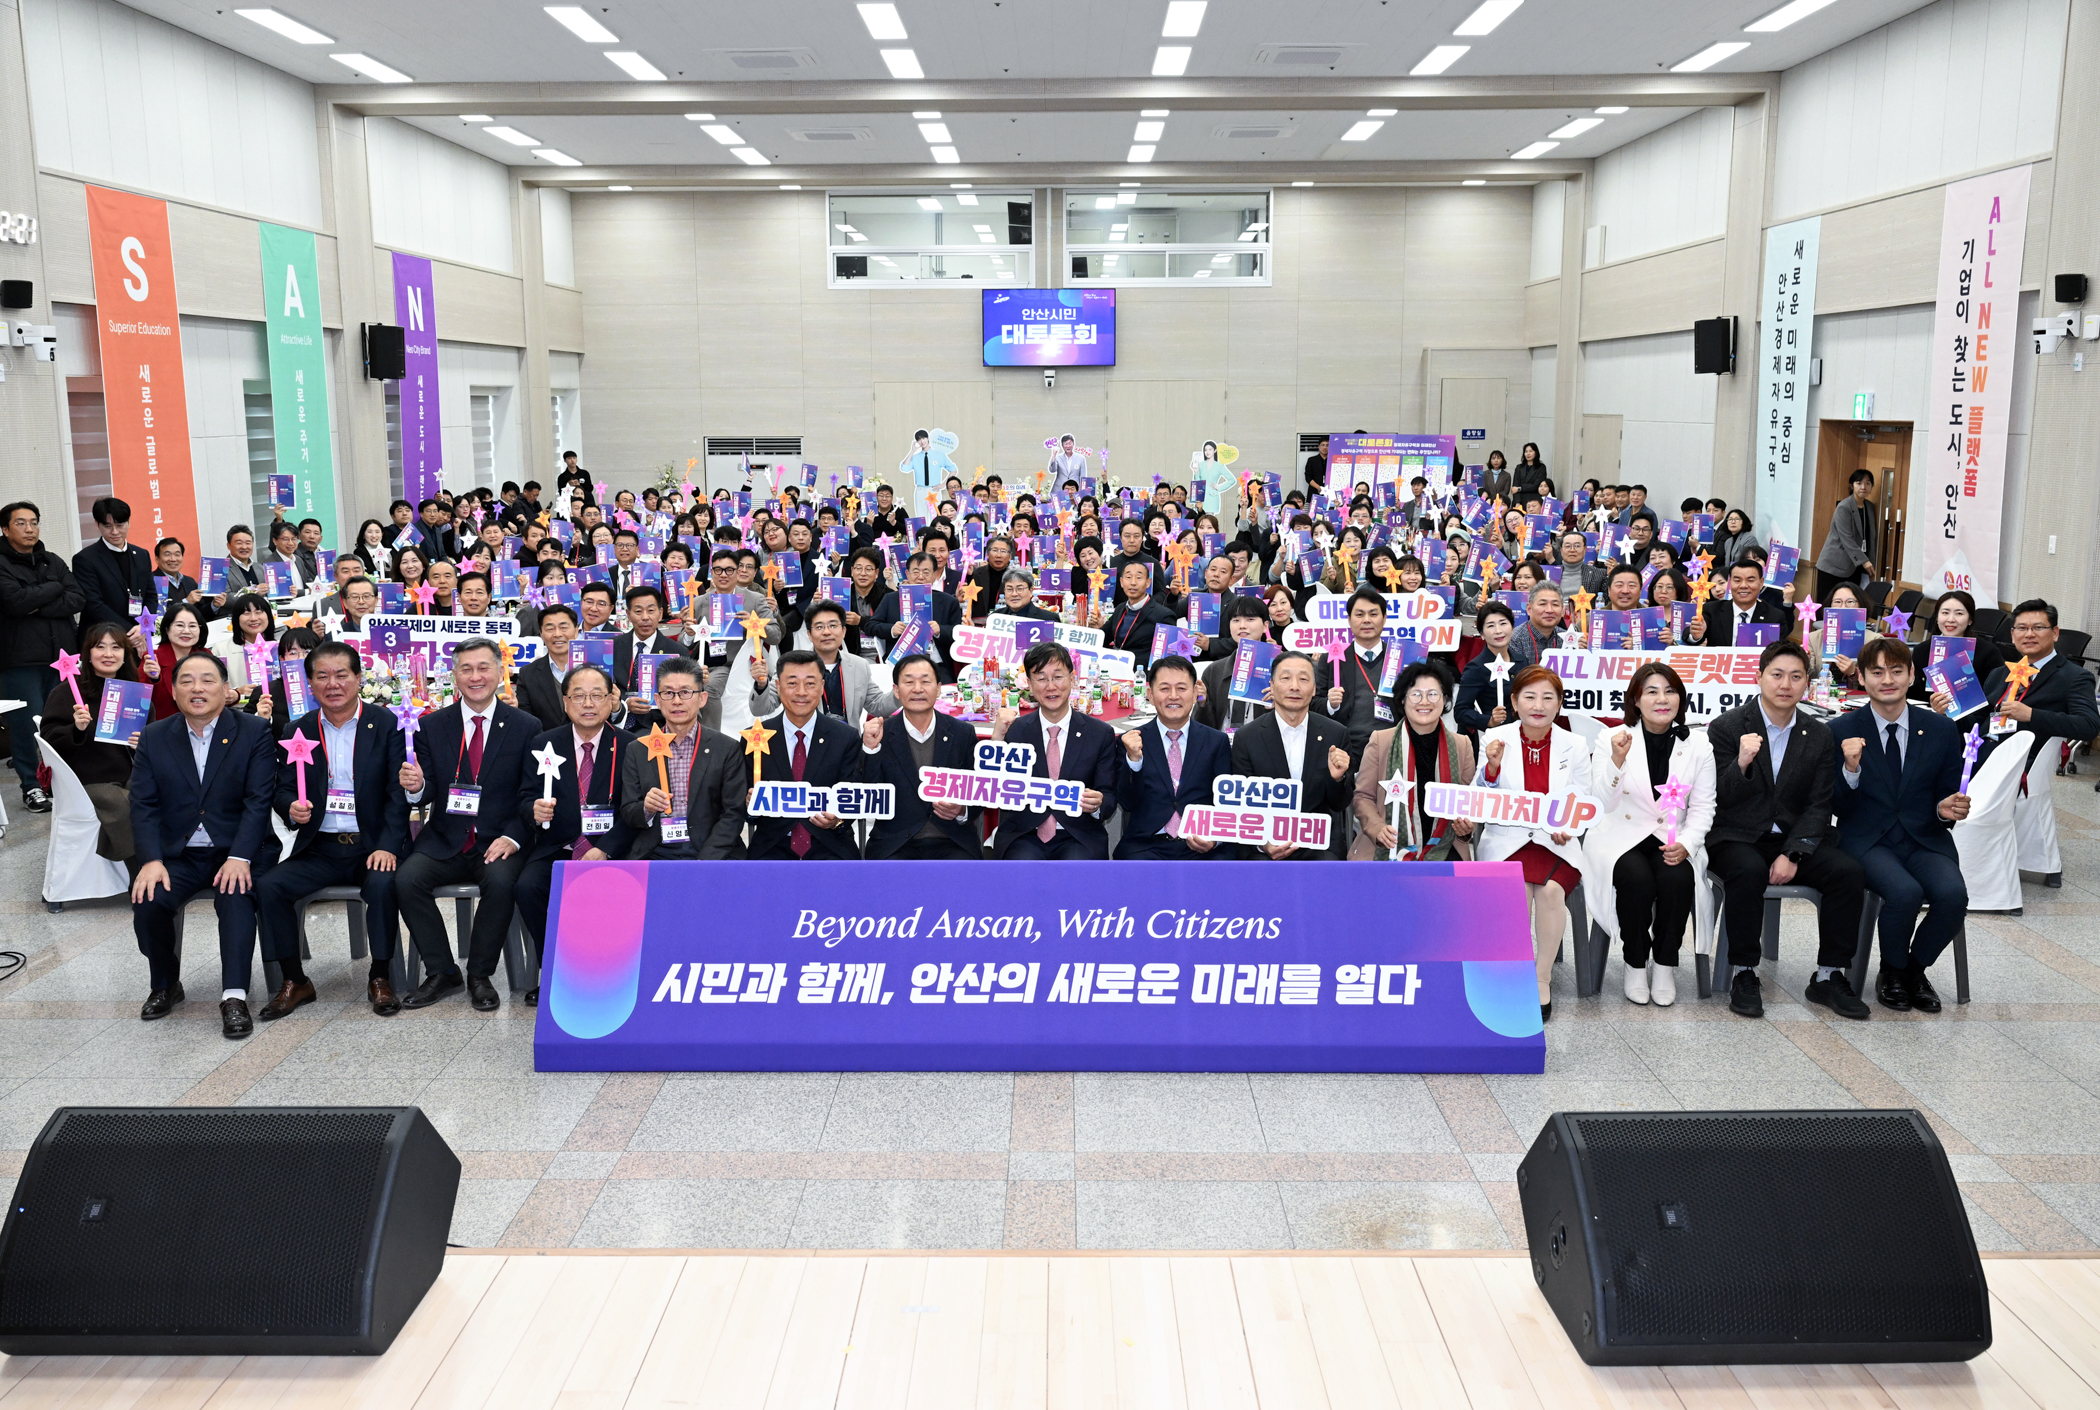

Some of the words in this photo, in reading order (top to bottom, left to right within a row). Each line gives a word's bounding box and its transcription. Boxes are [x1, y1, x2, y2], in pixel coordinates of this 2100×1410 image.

[1984, 195, 2001, 289] ALL
[120, 236, 149, 302] S
[1790, 239, 1804, 316] 새로운
[1955, 238, 1975, 325] 기업이
[284, 264, 305, 318] A
[407, 285, 424, 332] N
[1021, 308, 1077, 321] 안산시민
[108, 319, 138, 336] Superior
[138, 321, 171, 336] Education
[280, 333, 303, 346] Attractive
[303, 334, 313, 346] Life
[1001, 323, 1097, 345] 대토론회
[413, 345, 421, 355] City
[421, 346, 431, 355] Brand
[1951, 335, 1969, 393] 찾는
[1971, 302, 1992, 393] NEW
[1768, 273, 1787, 483] 안산경제자유구역
[1784, 328, 1797, 402] 미래의
[295, 369, 306, 423] 새로운
[139, 364, 153, 428] 새로운
[146, 435, 160, 500] 글로벌
[1780, 416, 1792, 464] 중심
[1947, 404, 1964, 470] 도시,
[1963, 406, 1985, 498] 플랫폼
[1391, 515, 1402, 523] 10
[1943, 484, 1959, 540] 안산
[647, 540, 655, 551] 9
[567, 572, 577, 584] 6
[1050, 573, 1060, 586] 5
[1406, 594, 1439, 620] UP
[384, 631, 397, 647] 3
[441, 619, 481, 634] 새로운
[485, 620, 513, 635] 동력
[1029, 627, 1041, 643] 2
[1068, 629, 1098, 646] 함께
[1420, 625, 1454, 646] ON
[1754, 629, 1762, 645] 1
[1546, 655, 1590, 679] ALL
[1668, 653, 1761, 684] 플랫폼
[1562, 689, 1603, 711] 업이
[978, 744, 1032, 774] 안산
[752, 786, 829, 813] 시민과
[836, 787, 891, 815] 함께
[923, 770, 1080, 812] 경제자유구역
[1217, 779, 1298, 810] 안산의
[1428, 787, 1541, 824] 미래가치
[1546, 792, 1597, 830] UP
[1183, 809, 1265, 841] 새로운
[1272, 815, 1327, 845] 미래
[793, 906, 923, 946] Beyond
[926, 907, 1042, 943] Ansan,
[1058, 906, 1135, 939] With
[1146, 907, 1283, 940] Citizens
[651, 962, 788, 1004] 시민과
[796, 962, 895, 1005] 함께,
[909, 962, 1041, 1005] 안산의
[1046, 963, 1180, 1005] 새로운
[1190, 963, 1322, 1005] 미래를
[1335, 964, 1422, 1005] 열다
